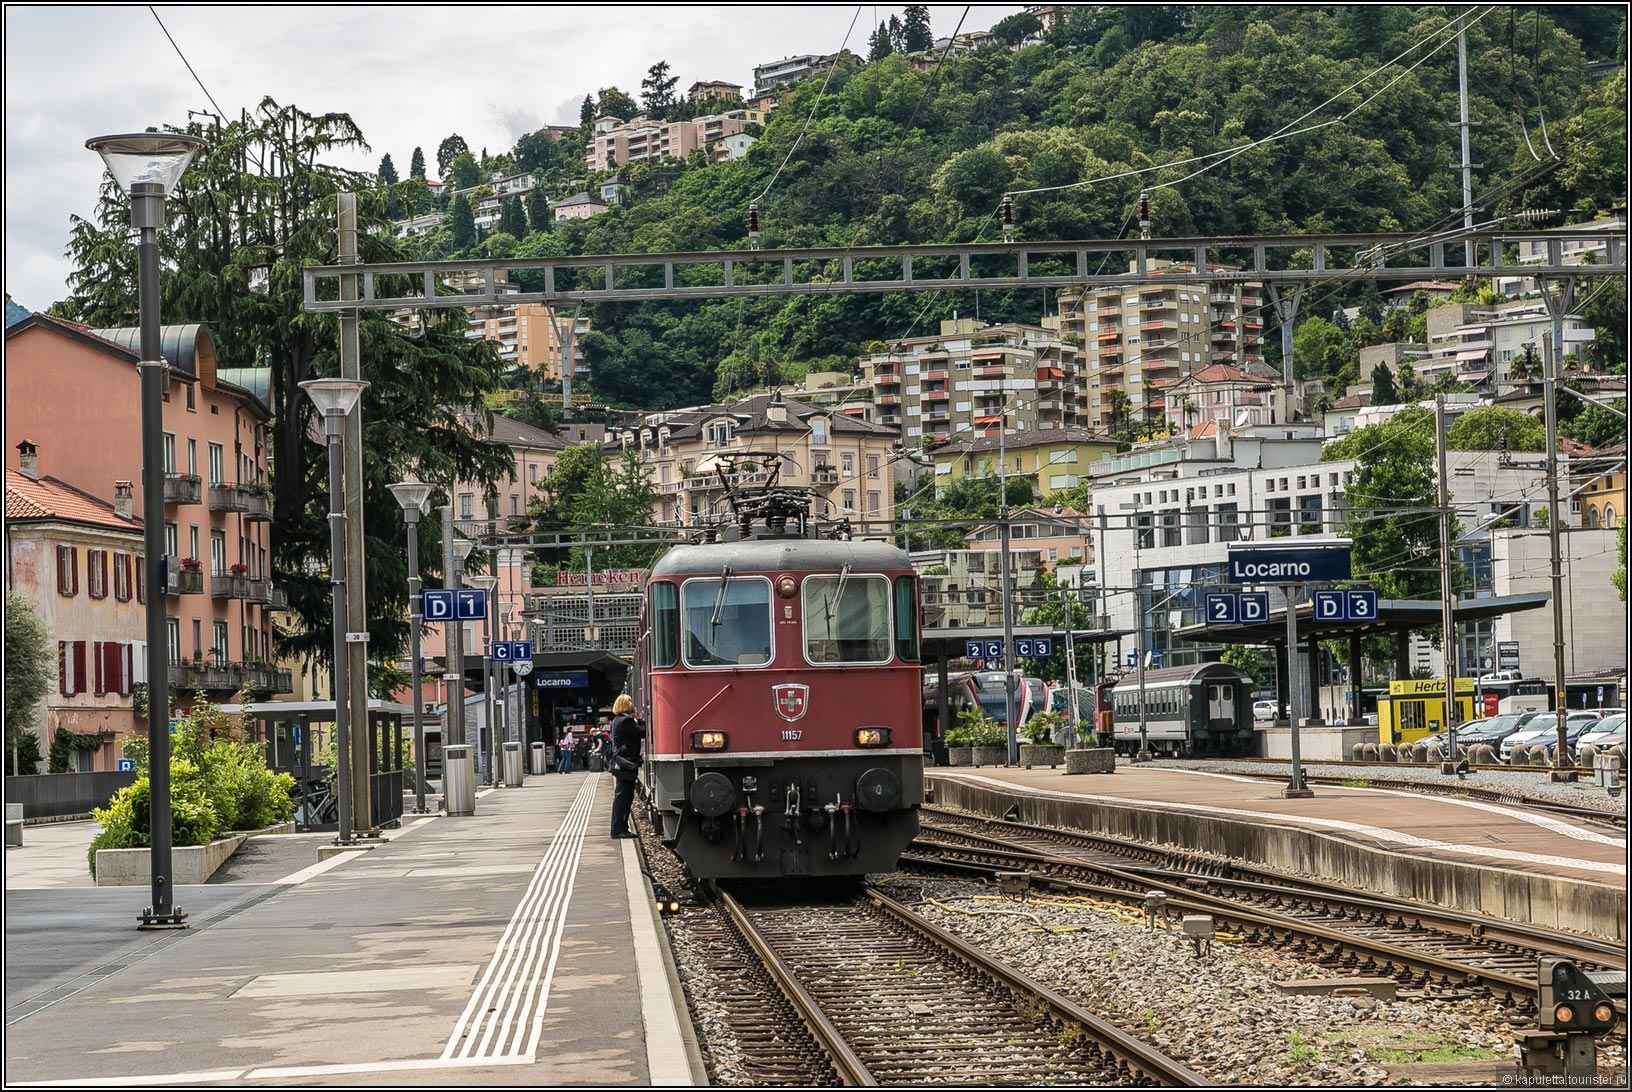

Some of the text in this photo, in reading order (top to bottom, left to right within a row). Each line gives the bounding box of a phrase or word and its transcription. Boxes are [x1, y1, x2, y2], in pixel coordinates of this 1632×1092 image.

[1234, 561, 1311, 577] Locarno
[556, 570, 640, 586] Heineken
[432, 598, 474, 616] D 1
[1215, 601, 1261, 619] 2 D
[1323, 599, 1368, 616] D 3
[497, 646, 525, 658] C 1
[971, 645, 998, 656] 2 C
[1020, 644, 1046, 655] C 3
[536, 678, 572, 687] Locarno
[1414, 680, 1447, 693] Hertz
[781, 730, 803, 740] 11157
[1567, 990, 1591, 1000] 32 A
